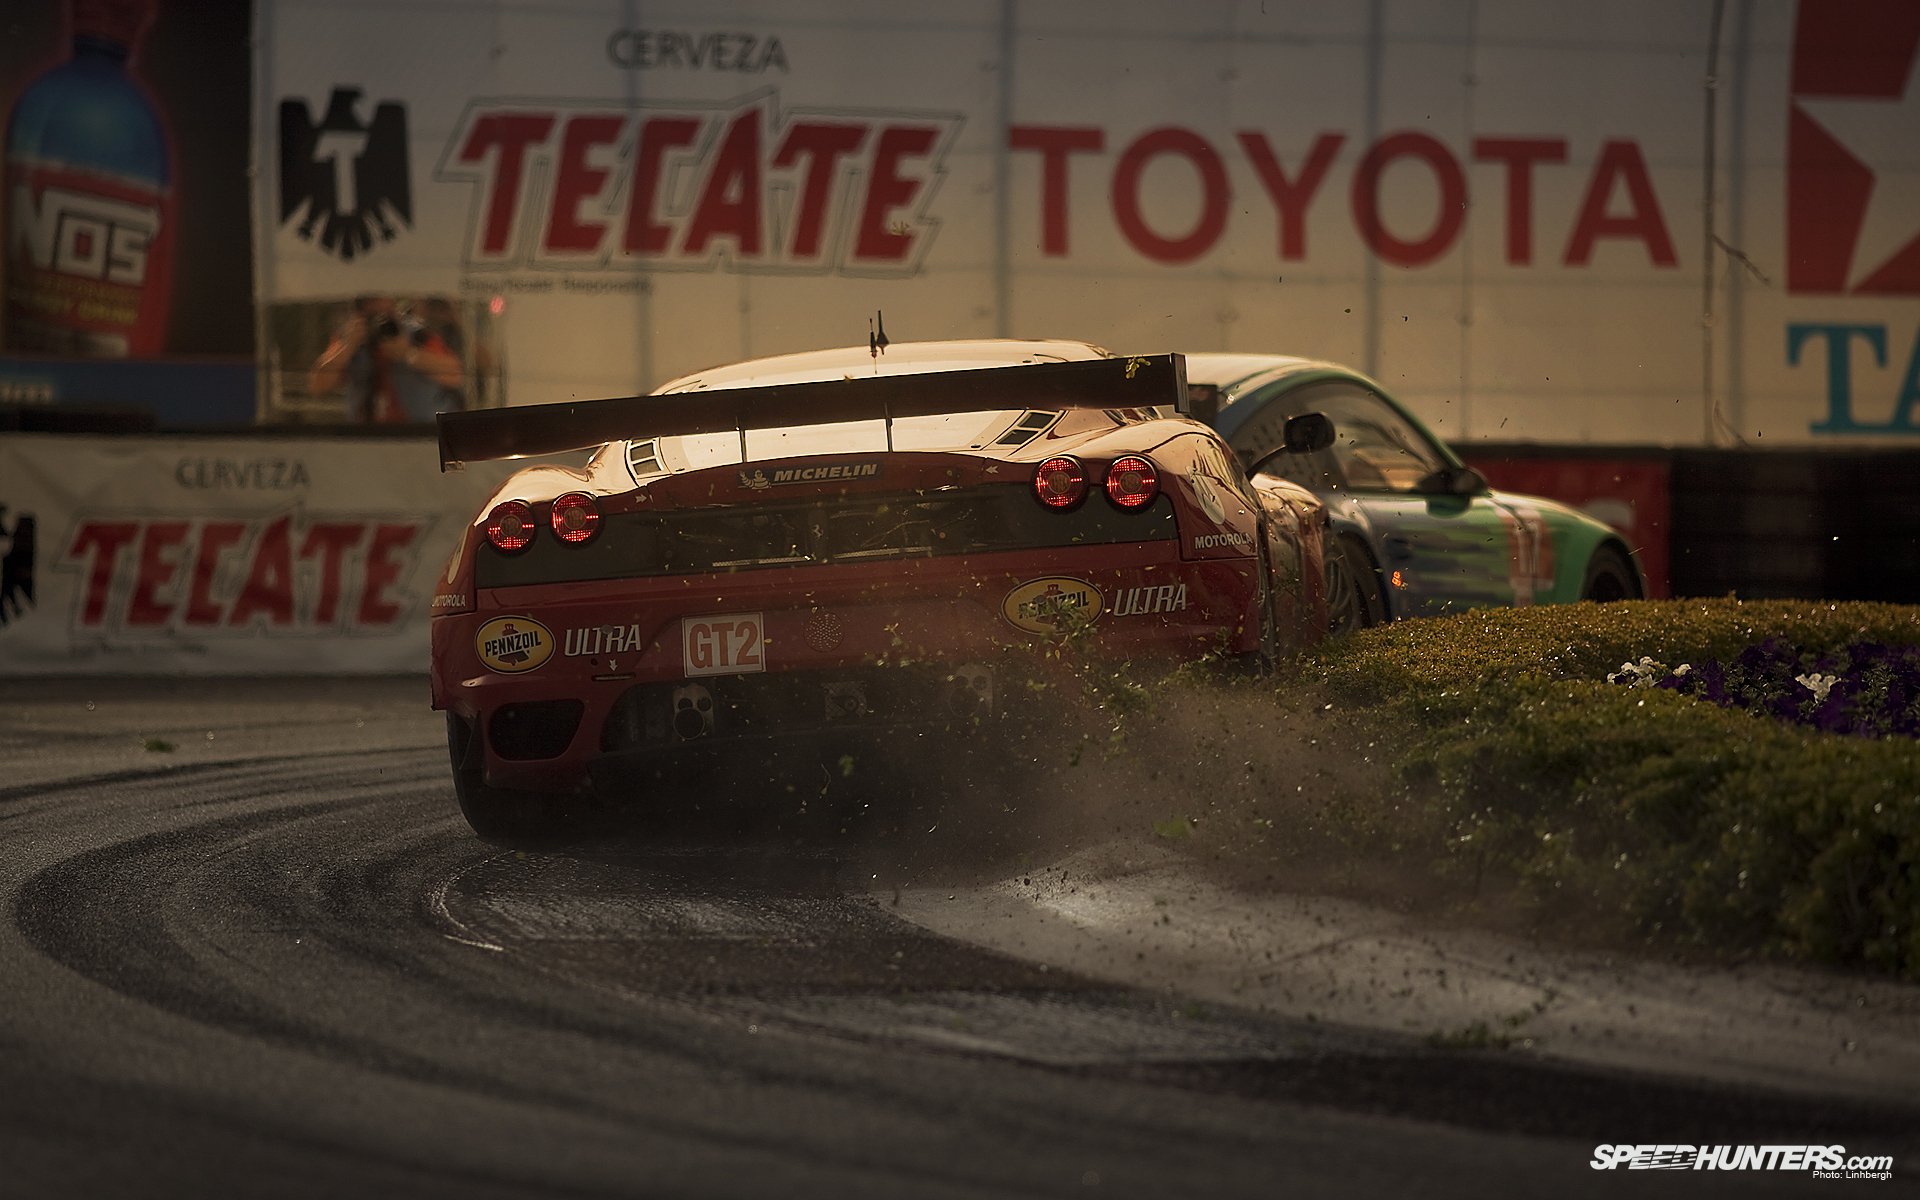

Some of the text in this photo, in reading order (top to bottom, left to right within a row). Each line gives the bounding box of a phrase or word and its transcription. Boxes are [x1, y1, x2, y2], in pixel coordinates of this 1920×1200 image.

[608, 29, 788, 72] CERVEZA
[1008, 124, 1678, 268] TOYOTA
[10, 185, 160, 286] NOS
[177, 459, 310, 490] CERVEZA
[774, 464, 878, 482] MICHELIN
[1194, 534, 1253, 549] MOTOROLA
[1113, 584, 1187, 617] ULTRA
[485, 631, 542, 657] PENNZOIL
[564, 624, 641, 657] ULTRA
[688, 620, 761, 670] GT2
